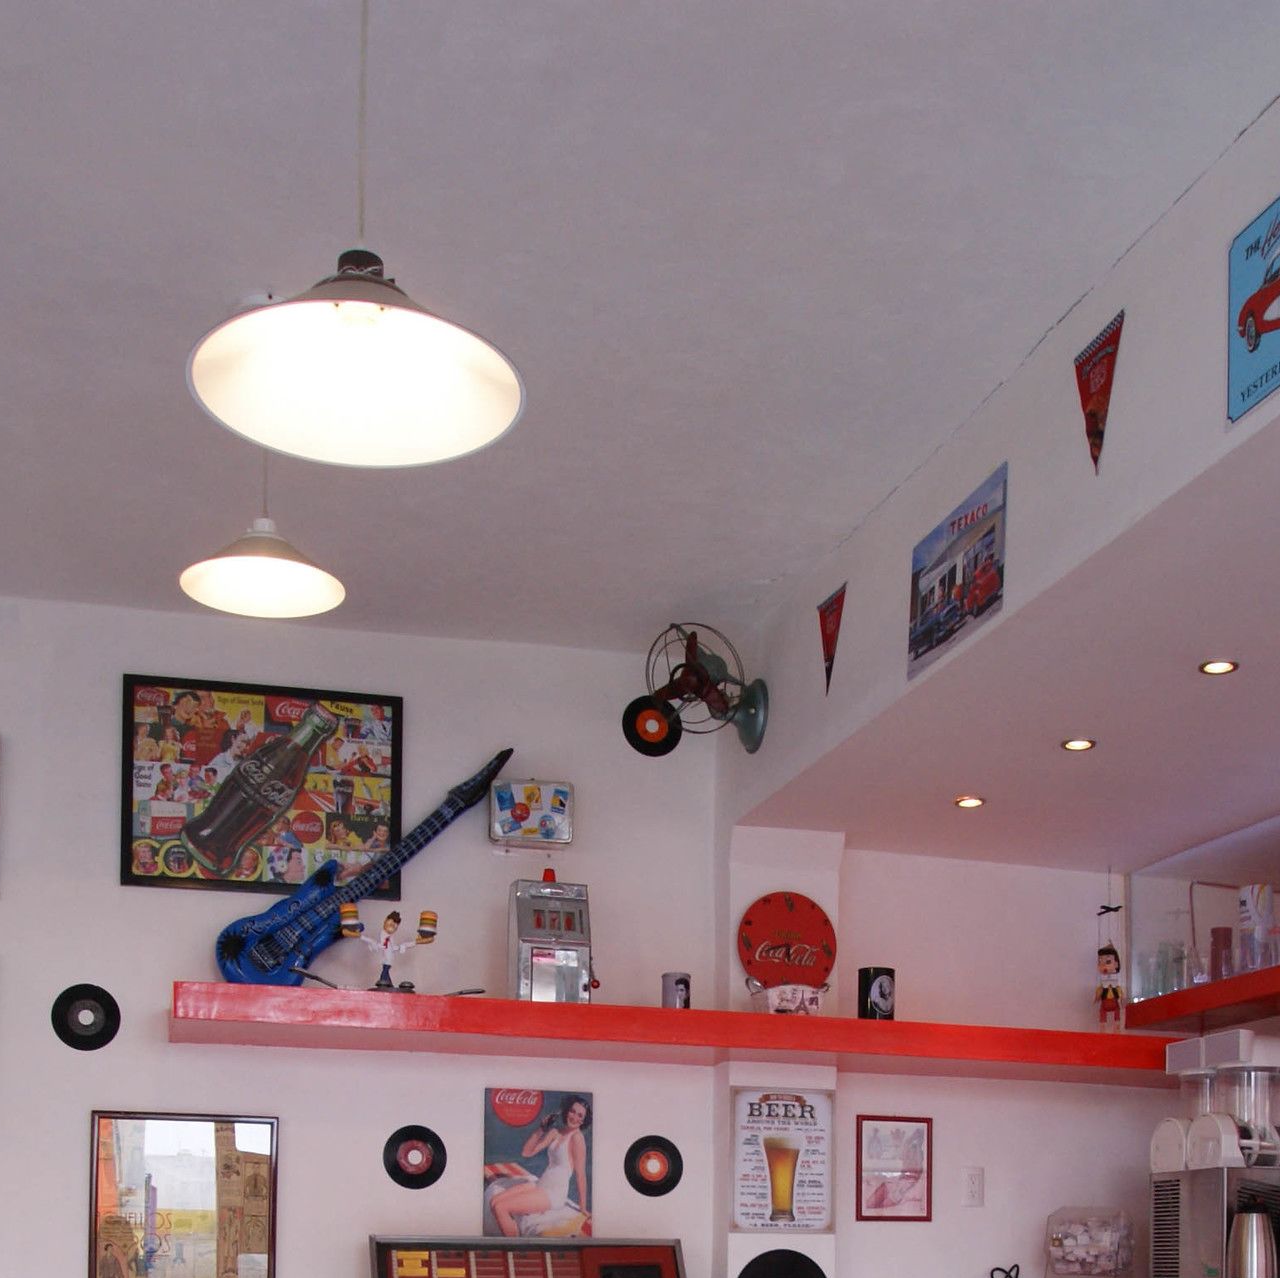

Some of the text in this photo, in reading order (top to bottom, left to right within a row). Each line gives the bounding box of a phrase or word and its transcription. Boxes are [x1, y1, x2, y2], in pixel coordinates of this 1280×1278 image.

[1245, 236, 1261, 260] THE
[951, 503, 988, 536] TEXACO
[748, 1102, 816, 1119] BEER
